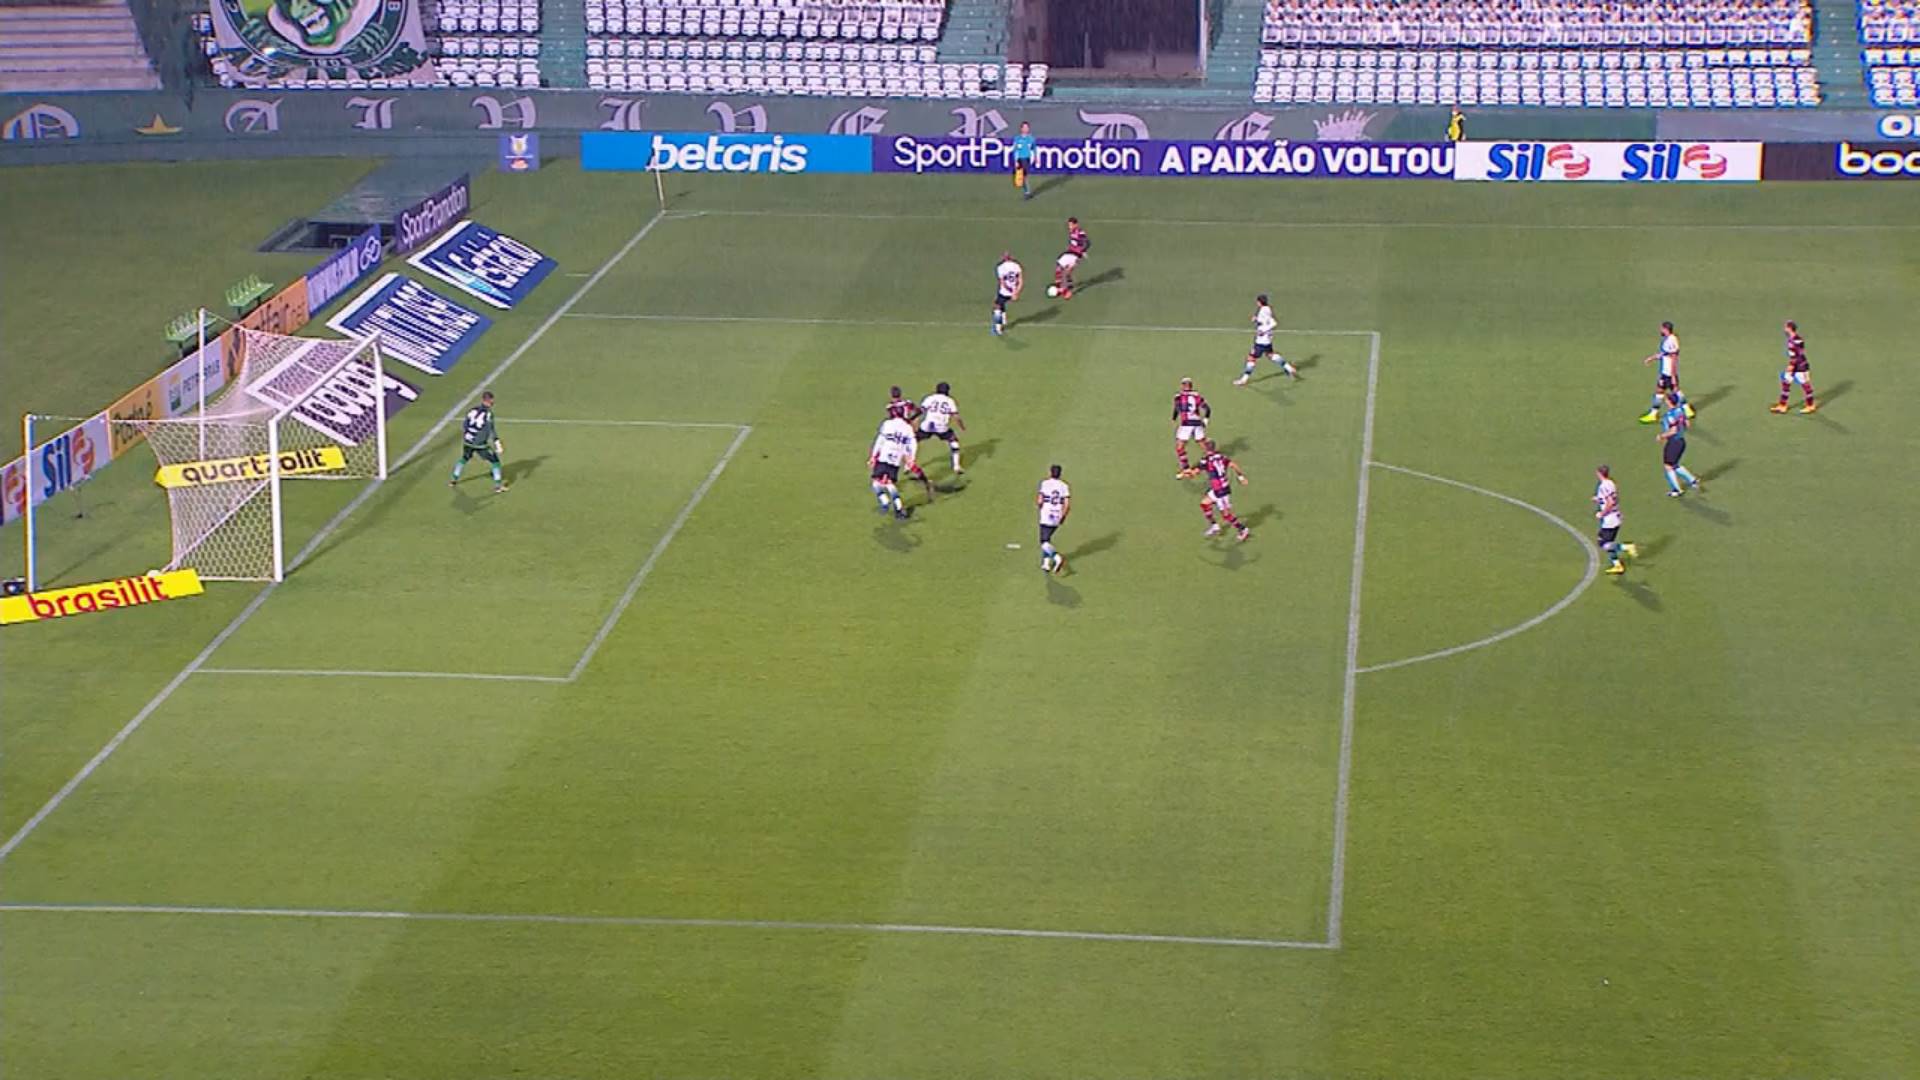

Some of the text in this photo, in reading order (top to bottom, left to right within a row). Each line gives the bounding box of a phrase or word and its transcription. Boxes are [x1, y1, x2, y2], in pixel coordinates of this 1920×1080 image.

[651, 136, 808, 172] betcris
[894, 136, 1141, 173] SportPrmotion
[1160, 140, 1454, 174] A PAIXÃO VOLTOU
[1486, 144, 1546, 180] Sil
[1621, 144, 1682, 180] Sil
[402, 186, 468, 247] SportPromotion
[448, 230, 544, 290] Estácio
[43, 433, 73, 498] Sil
[26, 575, 169, 620] brasilit
